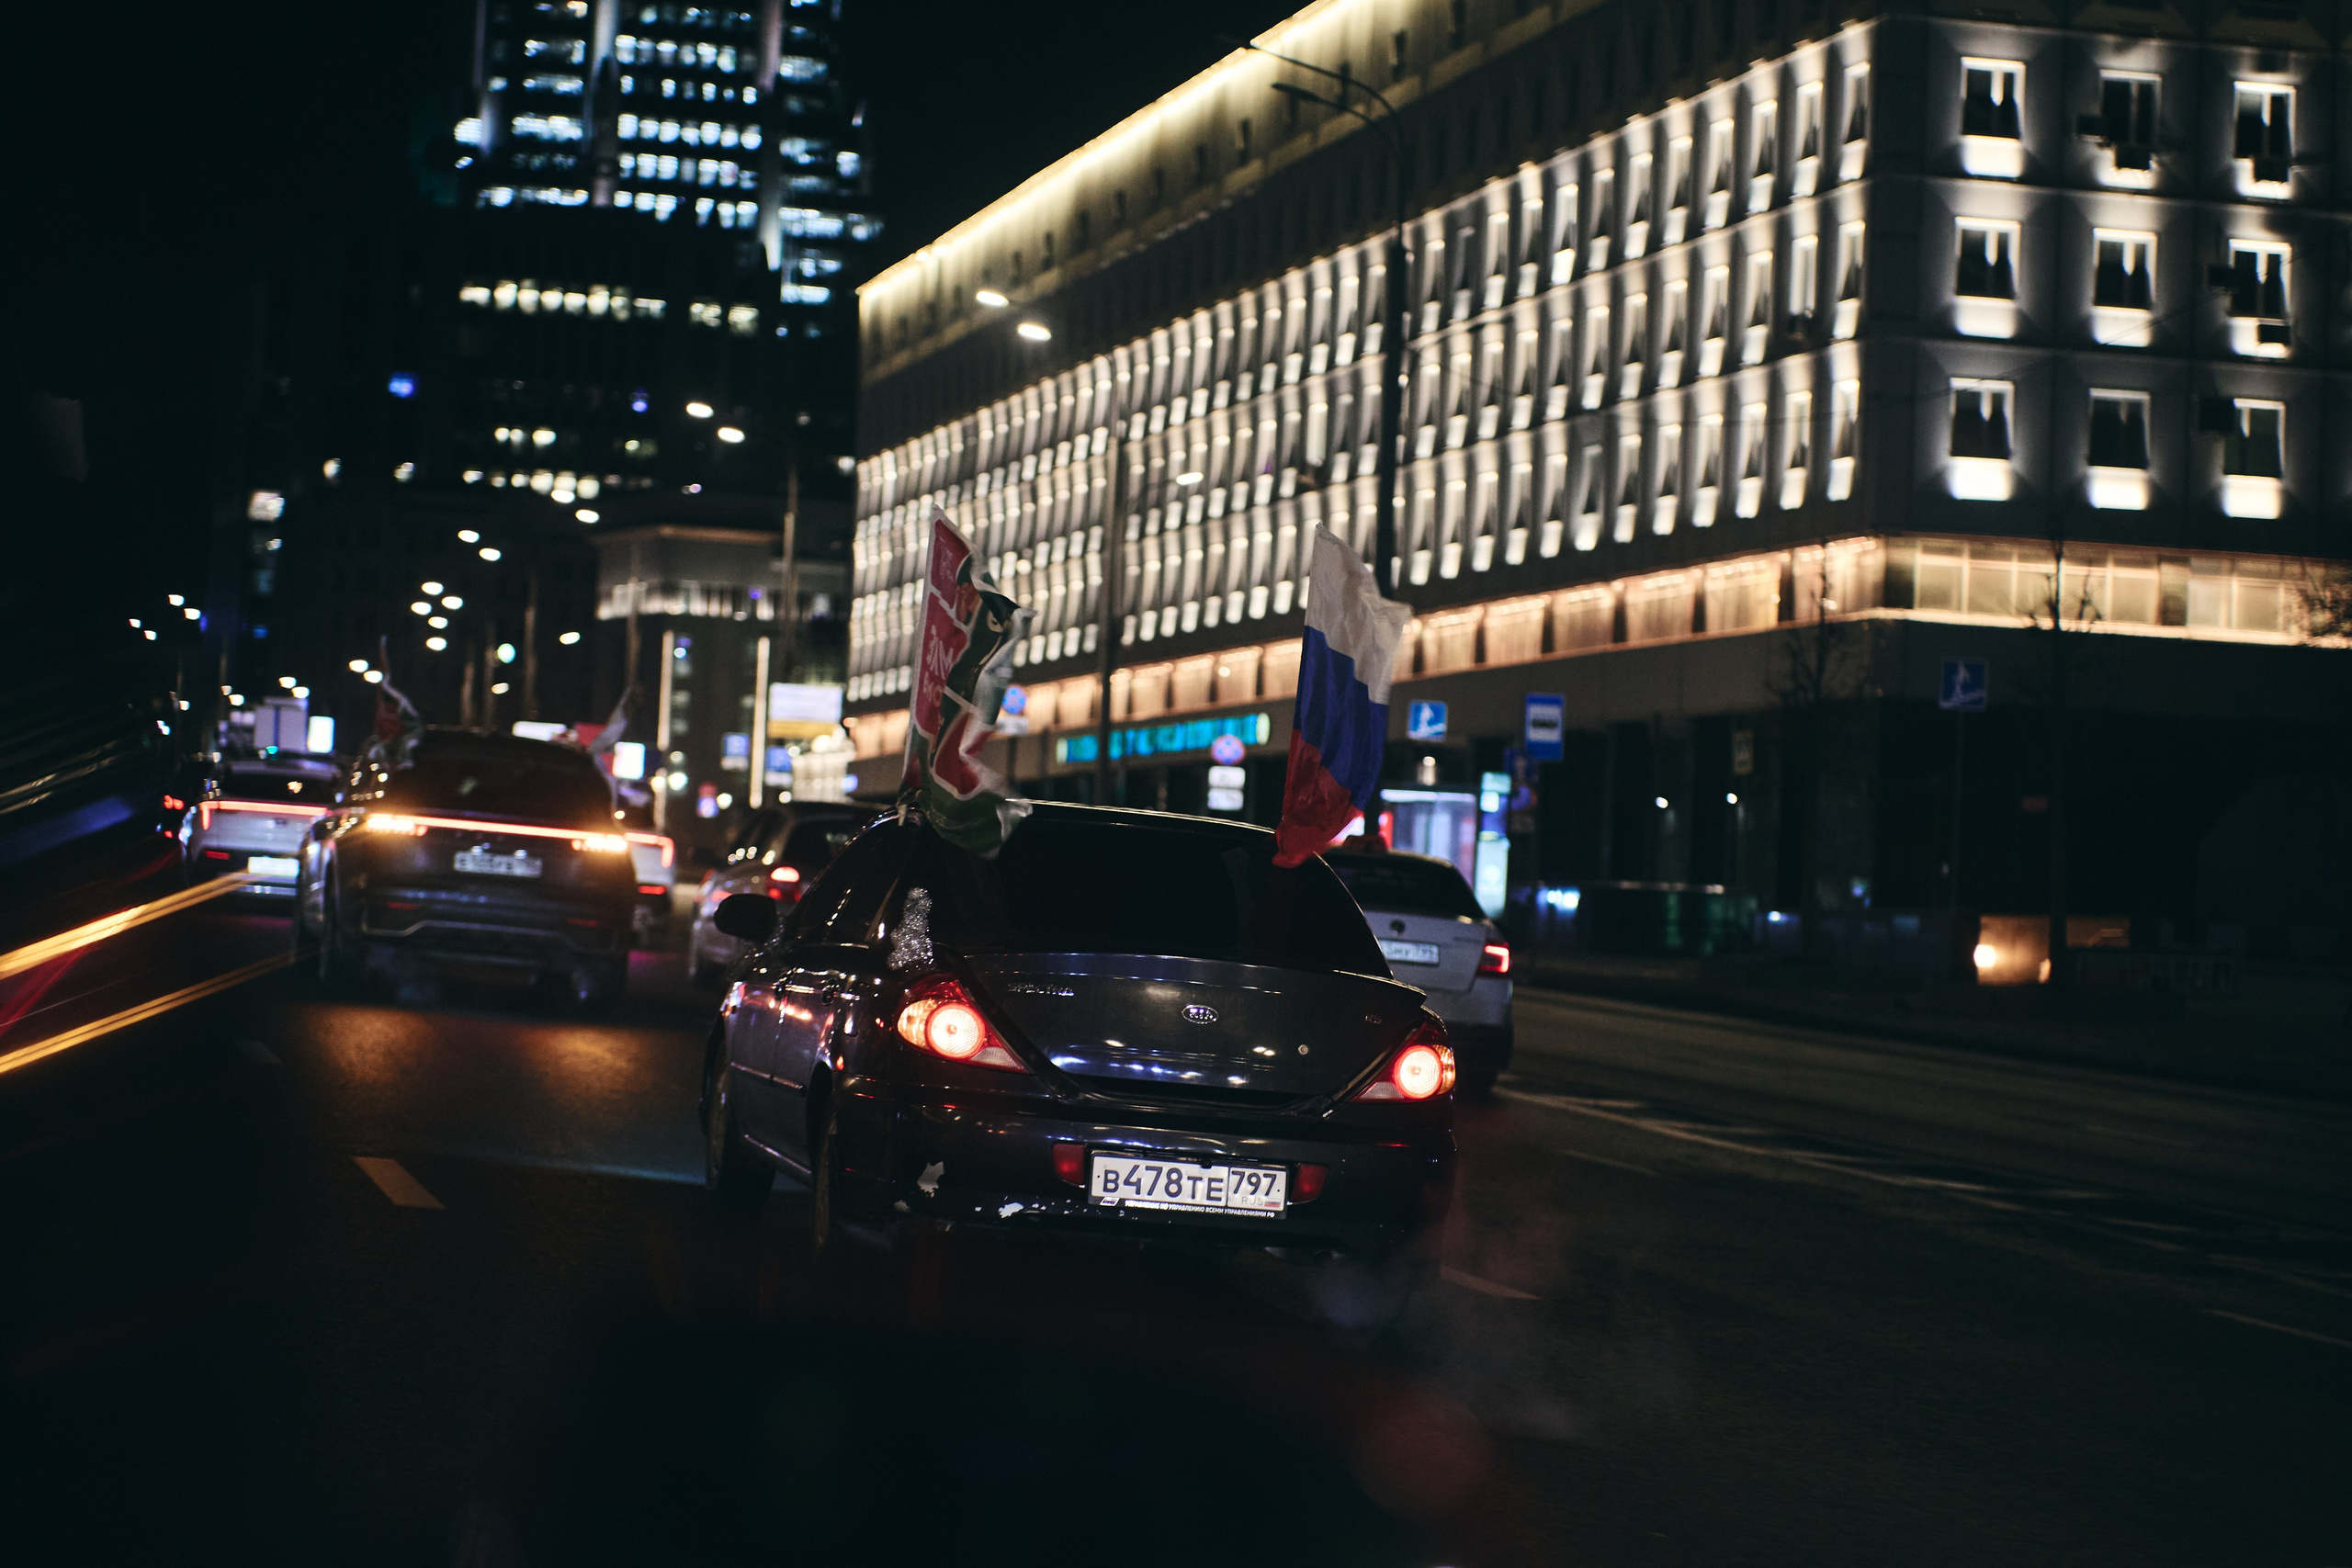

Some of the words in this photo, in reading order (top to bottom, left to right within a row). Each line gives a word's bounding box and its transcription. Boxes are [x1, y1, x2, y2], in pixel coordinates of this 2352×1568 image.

[1231, 1170, 1277, 1197] 797
[1241, 1196, 1264, 1206] RUS
[1169, 1203, 1204, 1213] УПРАВЛЕНИЮ
[1205, 1206, 1224, 1214] ВСЕМИ
[1225, 1208, 1267, 1217] УПРАВЛЕНИЯМИ
